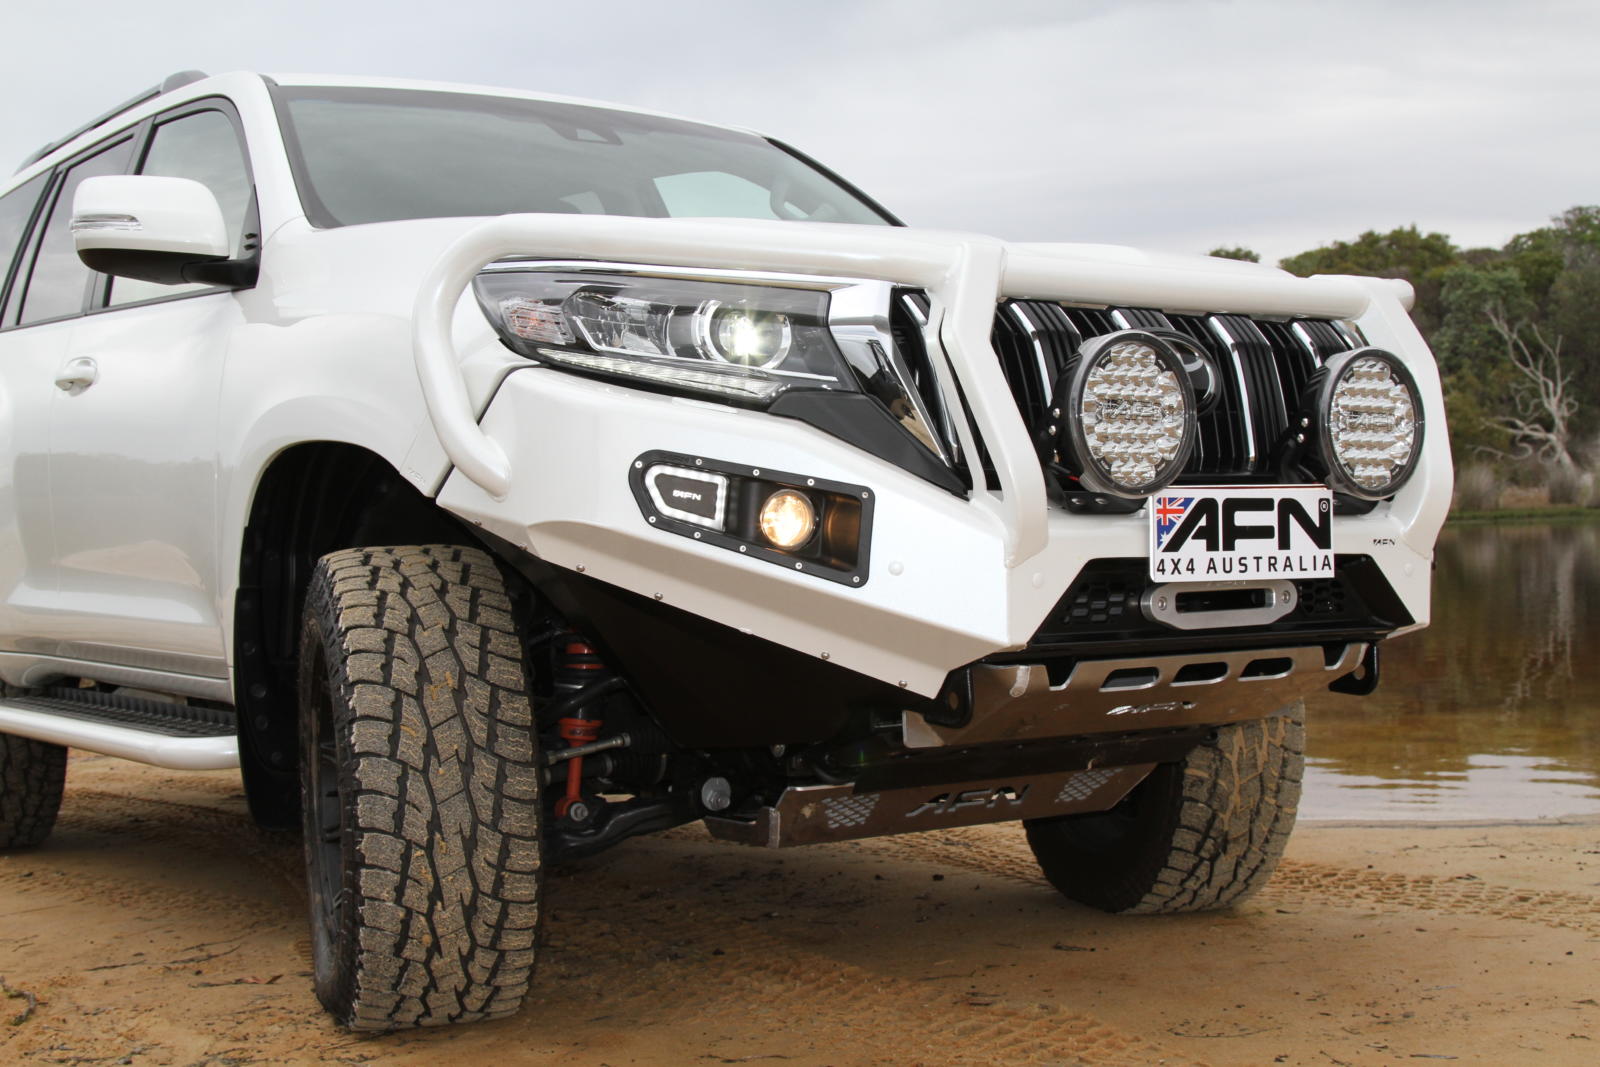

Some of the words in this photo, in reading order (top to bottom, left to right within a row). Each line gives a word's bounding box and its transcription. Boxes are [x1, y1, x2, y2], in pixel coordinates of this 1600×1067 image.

[1161, 498, 1332, 552] AFN
[1156, 557, 1196, 576] 4X4
[1206, 555, 1332, 574] AUSTRALIA
